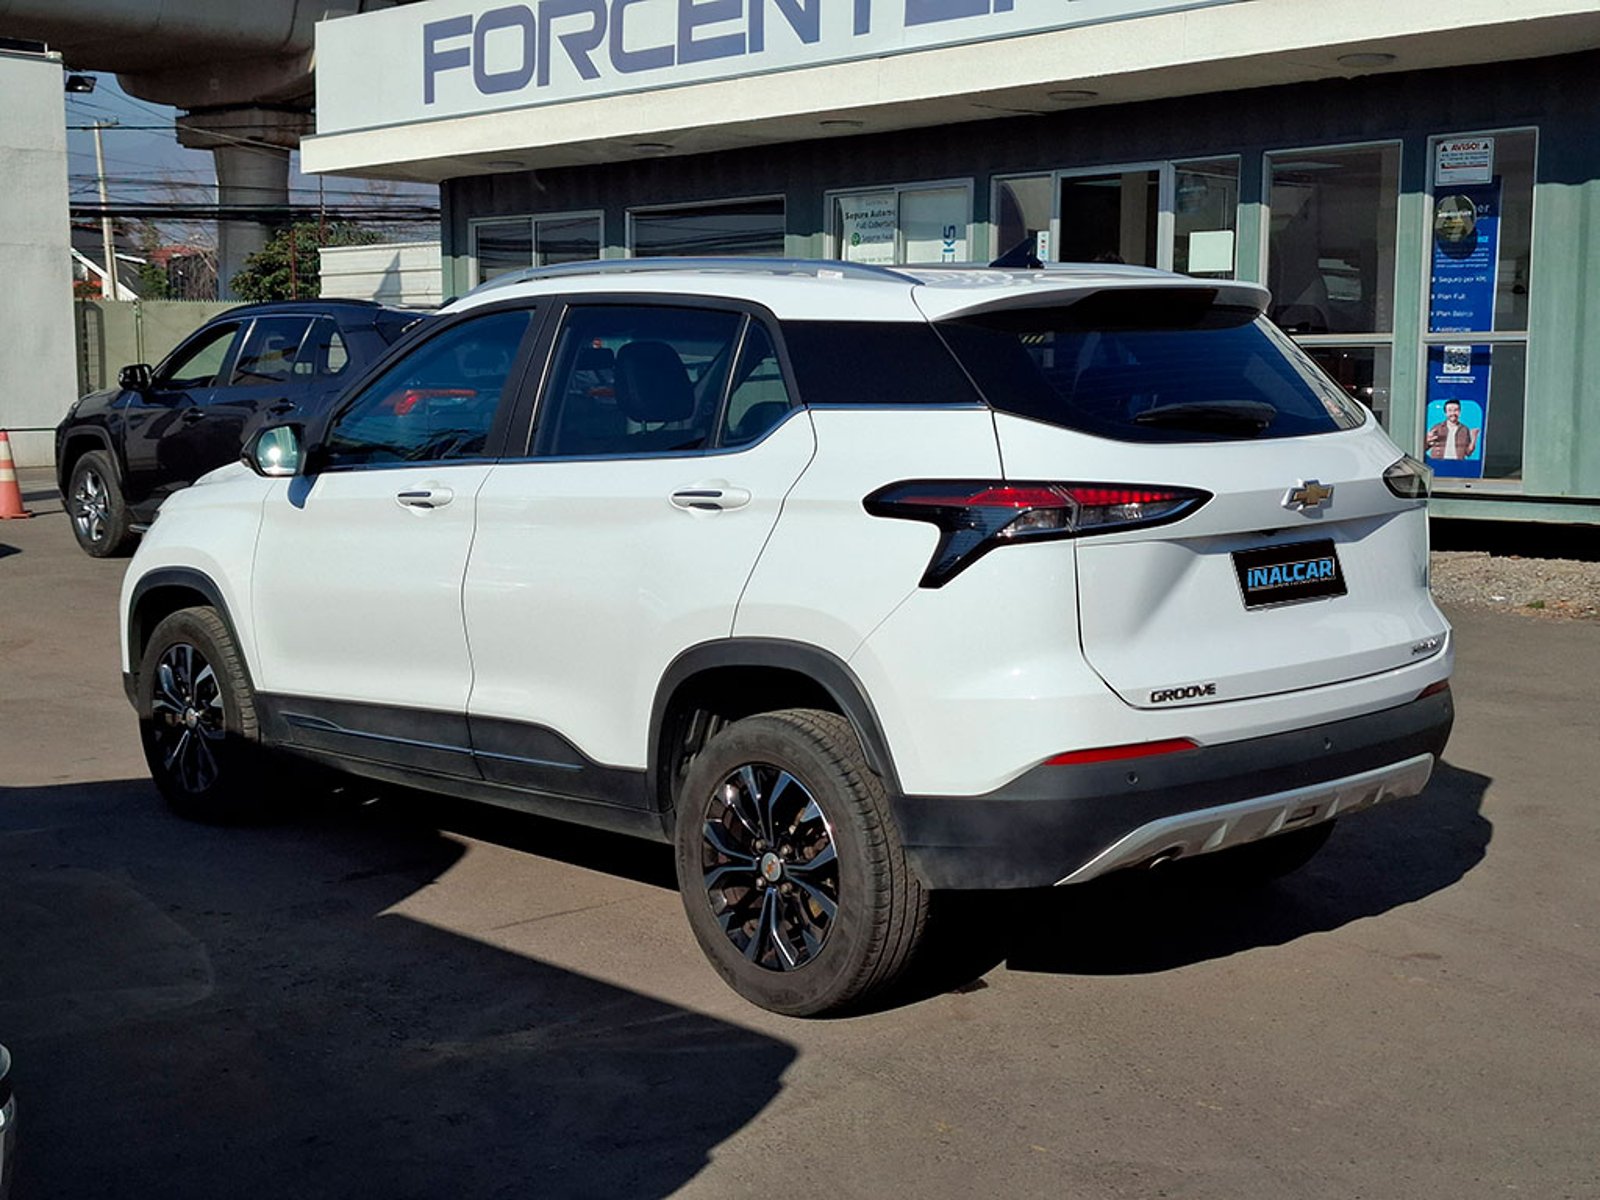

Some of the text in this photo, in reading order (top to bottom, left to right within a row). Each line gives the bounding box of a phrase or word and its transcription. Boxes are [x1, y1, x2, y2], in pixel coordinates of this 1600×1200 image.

[424, 0, 1015, 104] FORCEN
[1247, 559, 1332, 589] INALCAR
[1150, 682, 1217, 703] GROOVE
